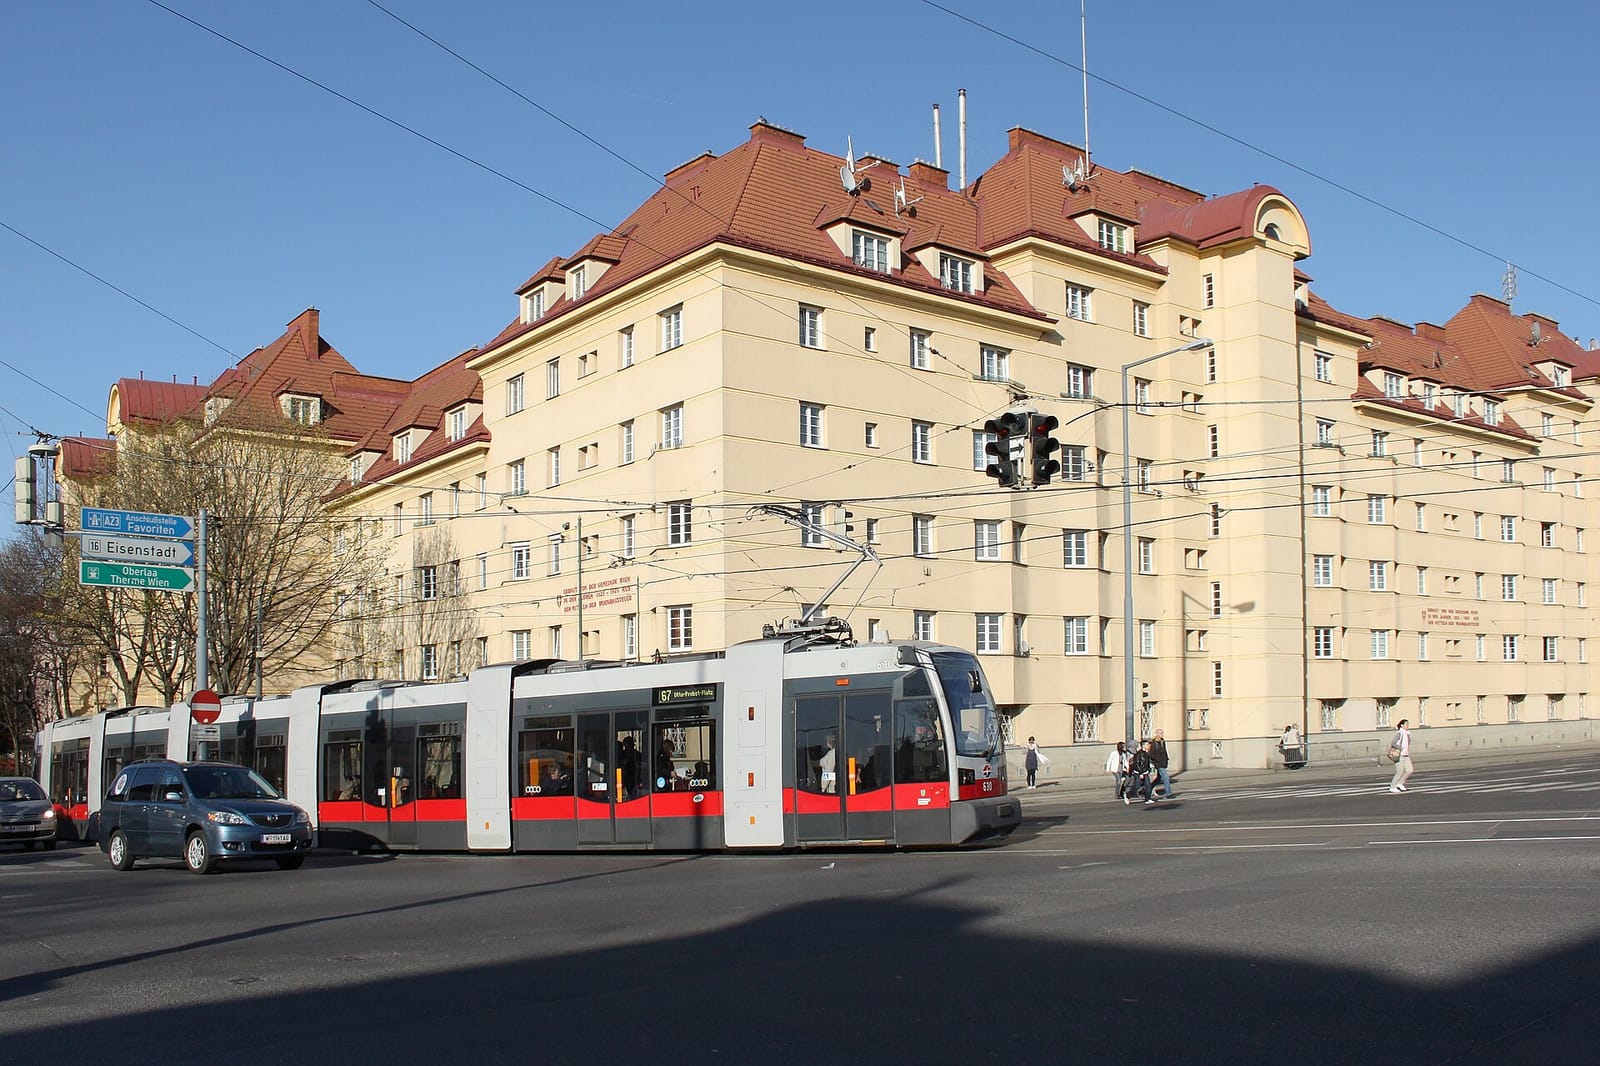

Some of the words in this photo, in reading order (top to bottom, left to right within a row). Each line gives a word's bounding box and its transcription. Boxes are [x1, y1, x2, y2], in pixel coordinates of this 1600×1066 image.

[104, 516, 120, 527] A23
[126, 514, 177, 526] Anschlußstelle
[127, 522, 175, 535] Favoriten
[90, 541, 99, 551] 16
[107, 542, 177, 558] Eisenstadt
[122, 566, 158, 577] Oberlaa
[110, 574, 145, 585] Therme
[148, 578, 169, 587] Wien
[876, 658, 893, 670] 630
[661, 690, 671, 701] 67
[982, 781, 993, 792] 630
